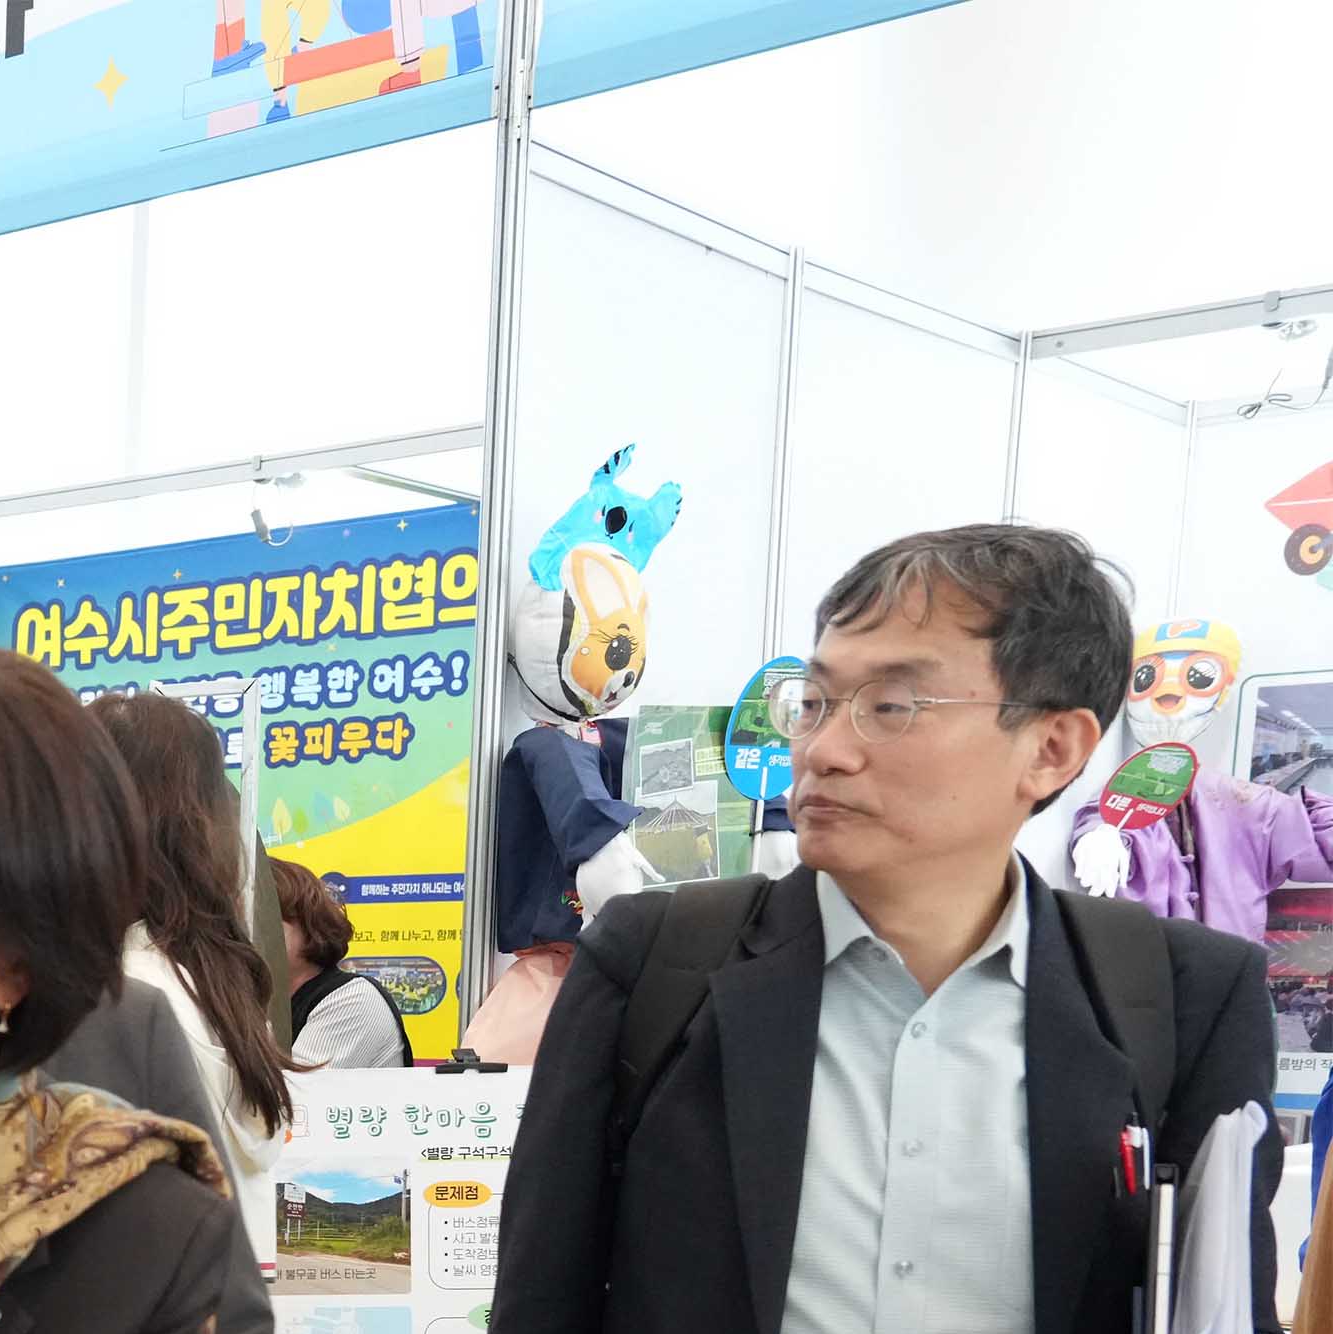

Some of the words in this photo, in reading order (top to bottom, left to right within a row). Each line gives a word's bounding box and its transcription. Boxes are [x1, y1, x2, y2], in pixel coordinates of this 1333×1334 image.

[371, 654, 467, 698] 여수!
[325, 1102, 389, 1140] 별량
[402, 1100, 499, 1139] 한마음
[435, 1185, 479, 1201] 문제점
